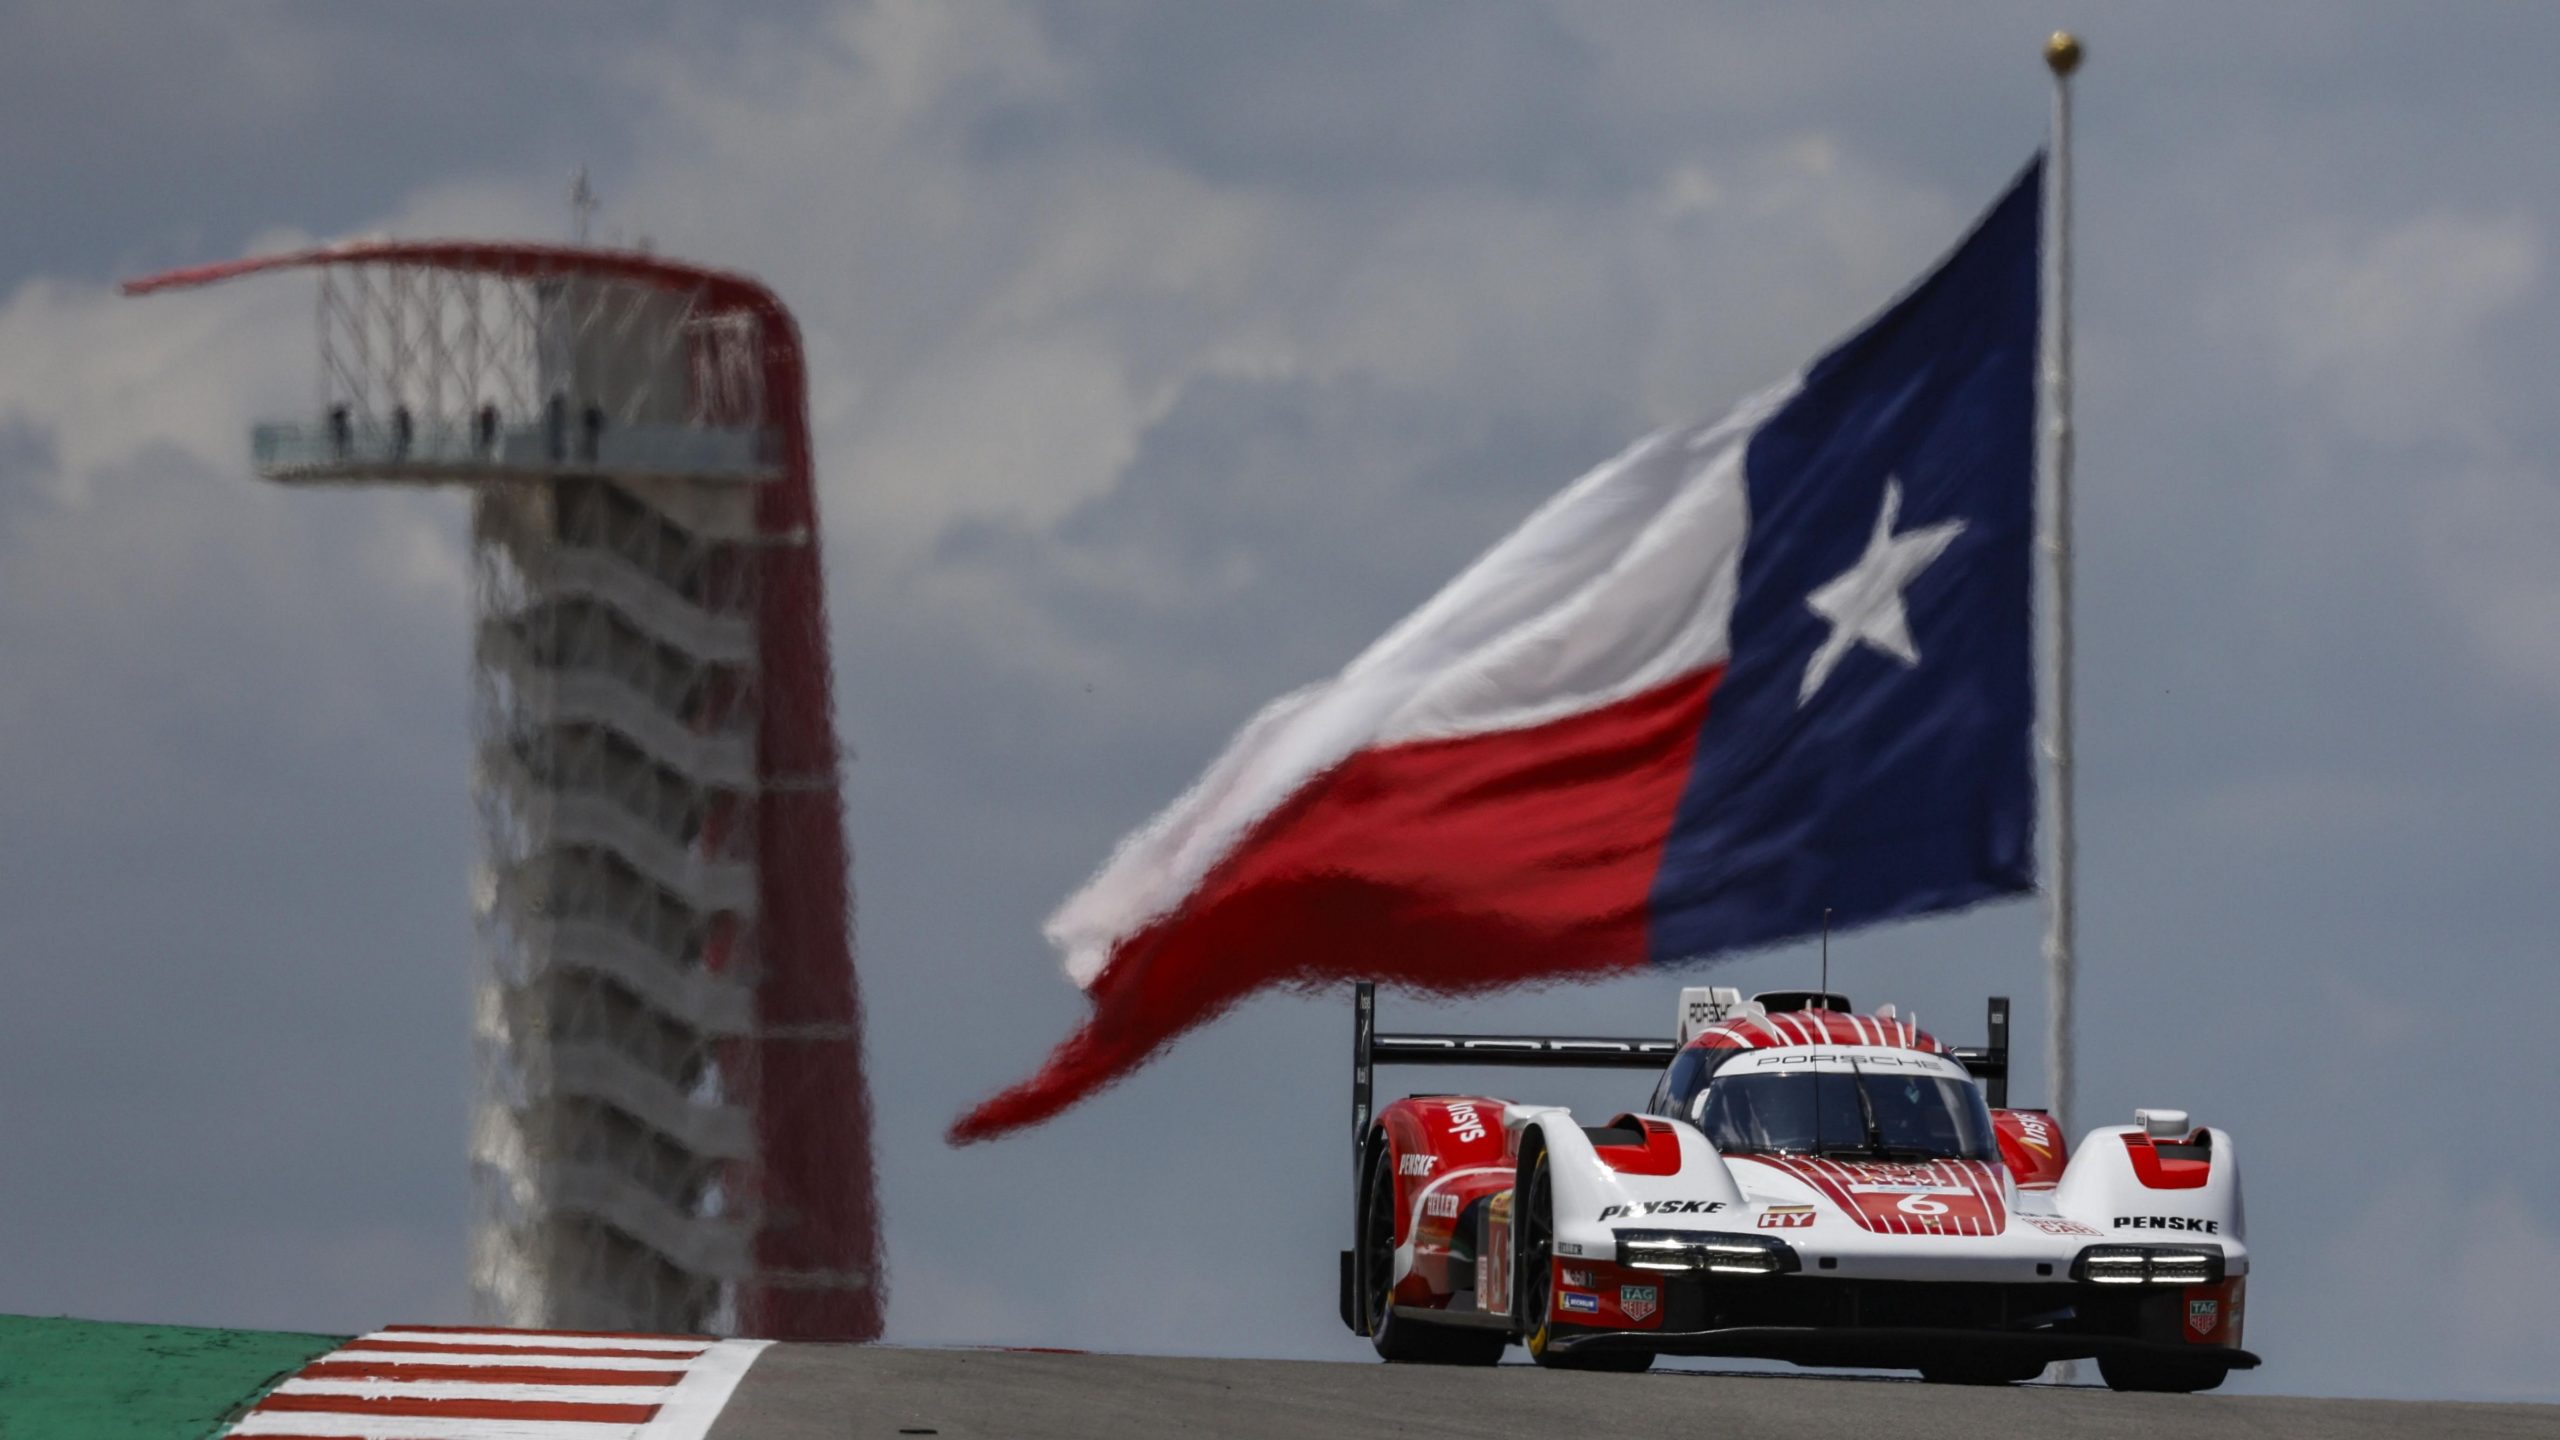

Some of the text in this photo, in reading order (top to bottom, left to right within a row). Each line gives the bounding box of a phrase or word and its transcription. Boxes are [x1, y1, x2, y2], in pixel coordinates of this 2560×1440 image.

[1689, 1003, 1733, 1023] PORSCH
[1757, 1055, 1944, 1071] PORSCHE
[1399, 1154, 1438, 1177] PENSKE
[1427, 1194, 1459, 1218] HELLER
[1897, 1194, 1949, 1215] 6
[1761, 1213, 1815, 1227] HY
[2113, 1216, 2218, 1235] PENSKE
[1624, 1288, 1653, 1300] TAG
[1623, 1301, 1653, 1318] HEUER
[2192, 1303, 2215, 1313] TAG
